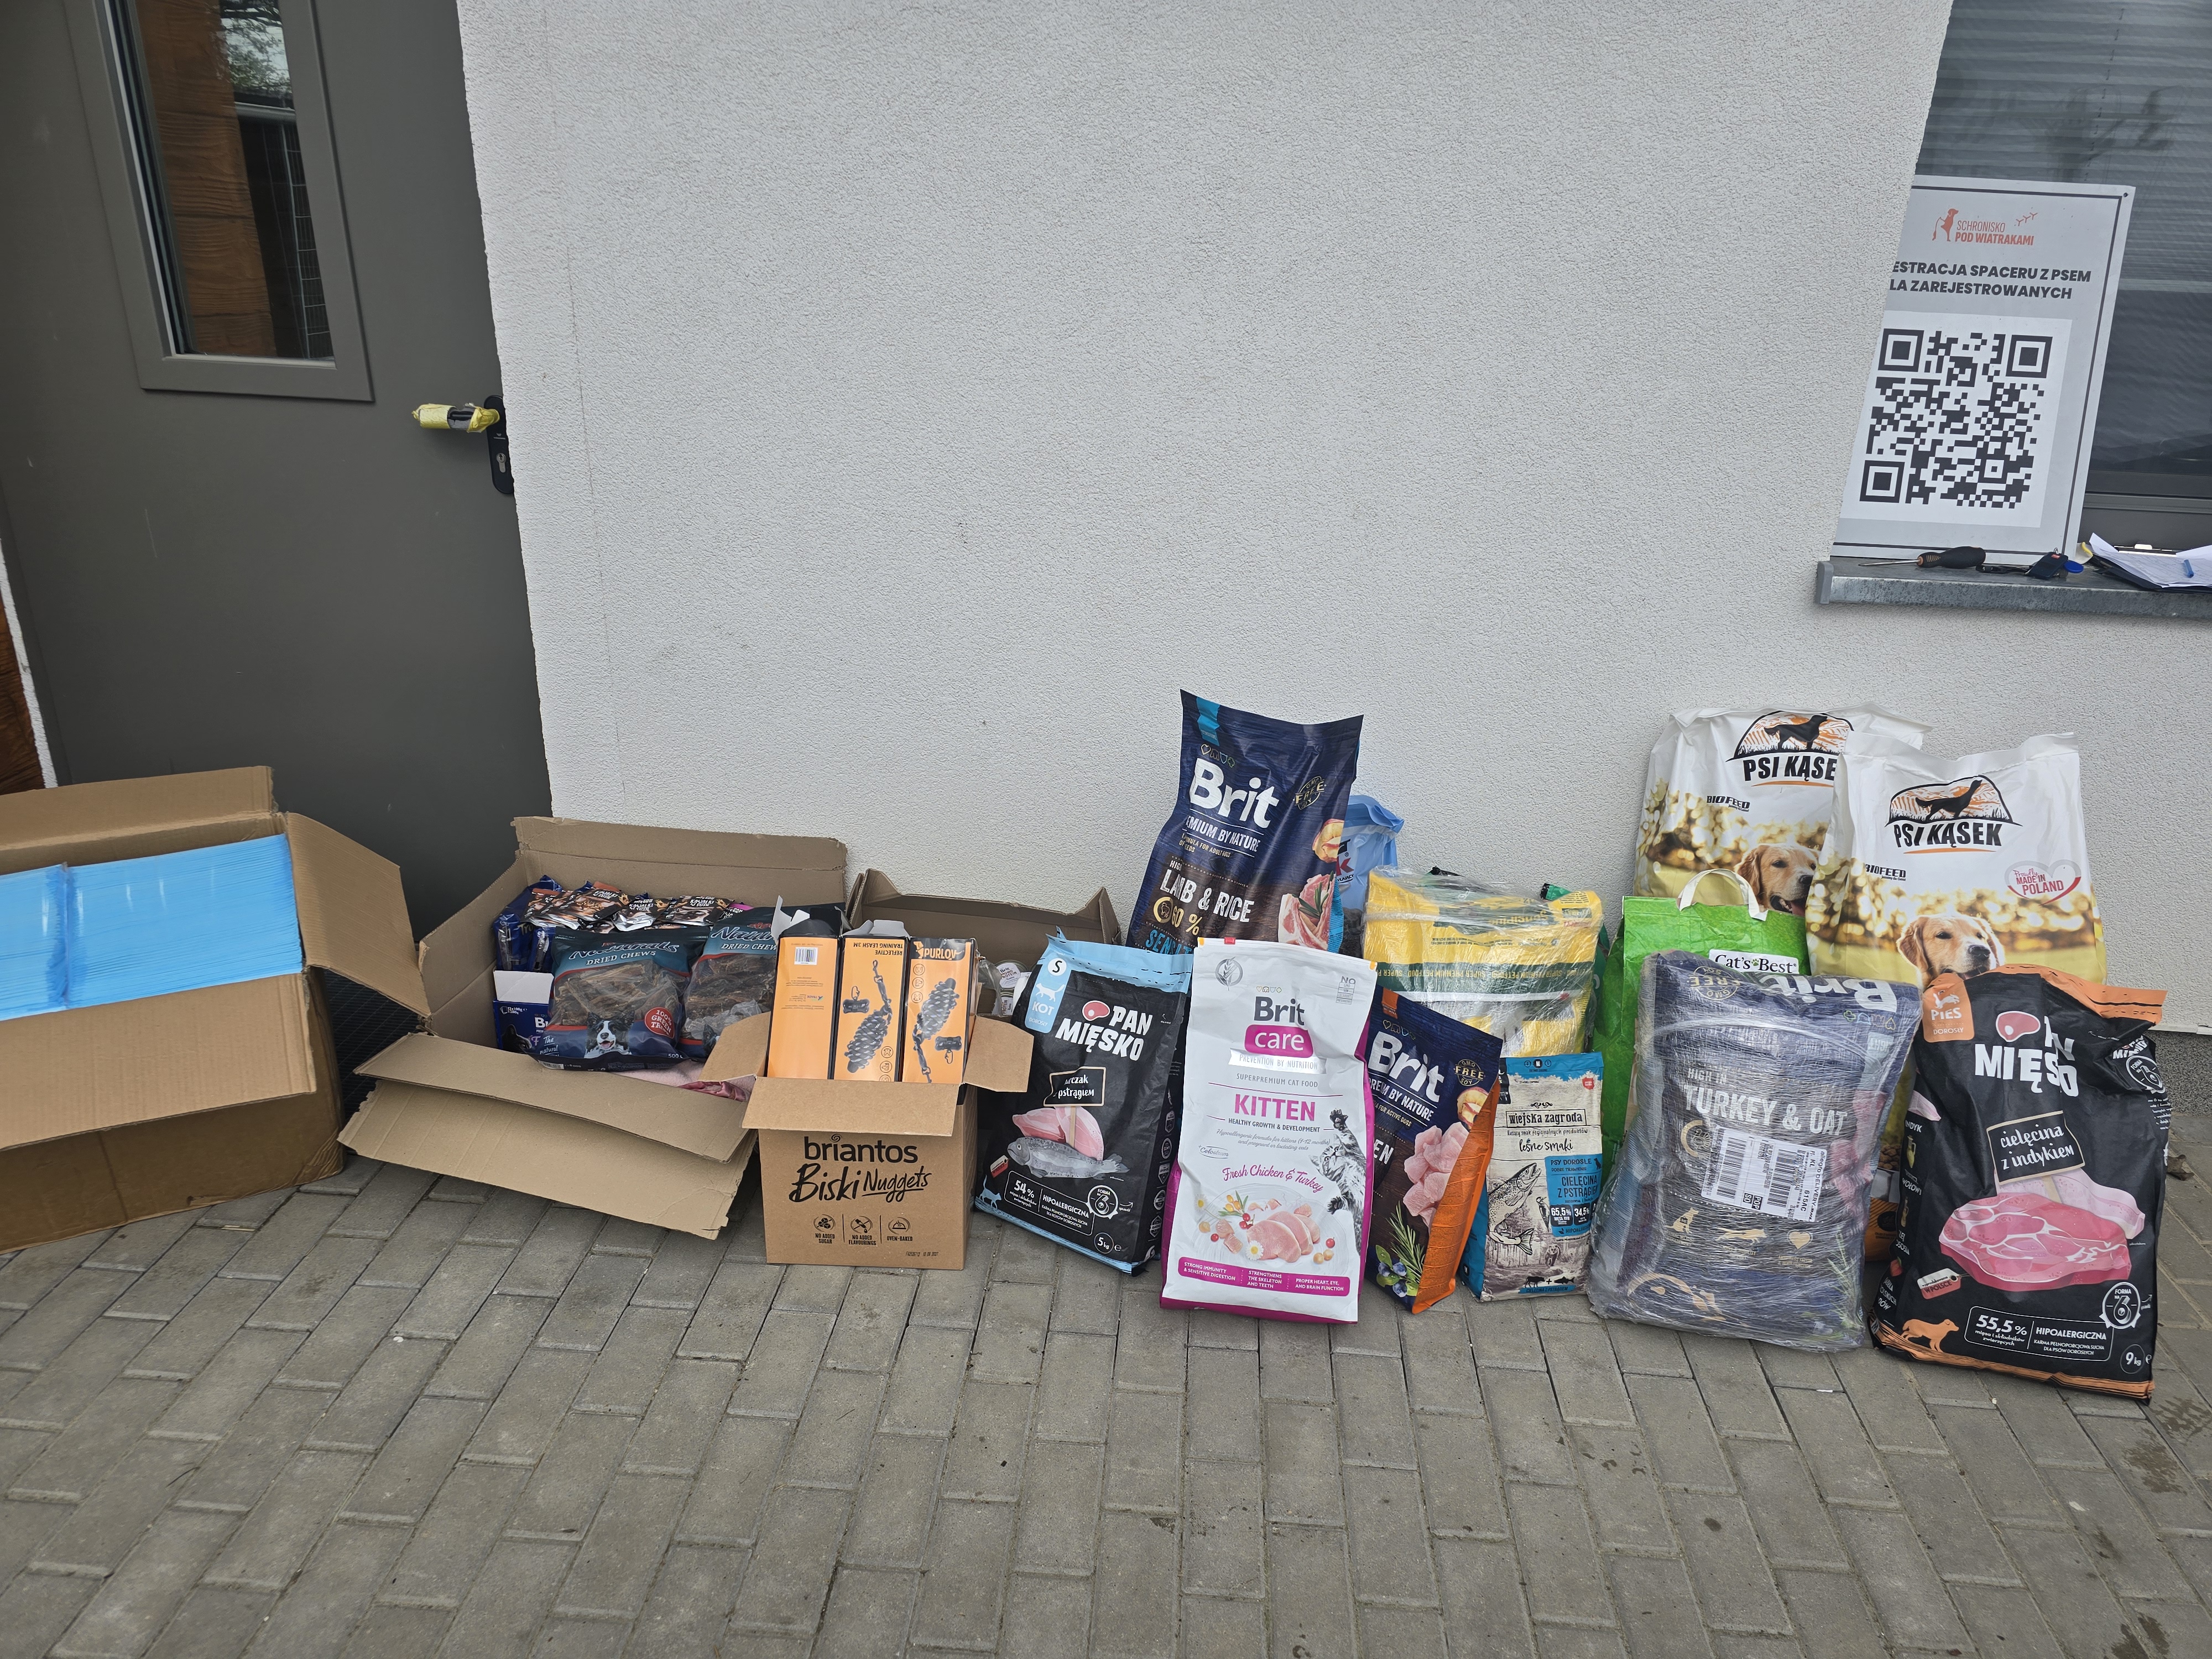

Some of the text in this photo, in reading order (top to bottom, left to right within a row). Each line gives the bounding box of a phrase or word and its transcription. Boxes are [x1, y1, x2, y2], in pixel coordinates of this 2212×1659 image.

[1957, 220, 2005, 232] SCHRONISKO
[1955, 232, 2034, 246] POD WIATRAKAMI
[1970, 265, 2038, 279] SPACERU
[2039, 268, 2049, 280] Z
[2051, 269, 2091, 282] PSEM
[1889, 279, 2073, 299] LA ZAREJESTROWANYCH
[1743, 756, 1780, 781] PSI
[1190, 758, 1280, 828] Brit
[1295, 781, 1325, 806] FREE
[1218, 829, 1232, 843] BY
[1229, 832, 1261, 852] NATURE
[1893, 821, 2002, 848] PSI KĄSEK
[1865, 864, 1906, 878] BIOFEED
[2012, 868, 2038, 878] Proudly
[2016, 874, 2046, 885] MADE IN
[2023, 880, 2064, 895] POLAND
[1198, 888, 1212, 911] &
[1213, 891, 1255, 922] RICE
[1185, 914, 1202, 936] %
[586, 951, 656, 966] DRIED CHEWS
[924, 948, 957, 960] PURLOV
[1052, 960, 1062, 973] S
[1715, 954, 1792, 973] Cat's Best
[1689, 975, 1741, 988] FREE
[1707, 988, 1731, 998] GMO
[1032, 1001, 1055, 1016] KOT
[1254, 996, 1305, 1026] Brit
[1931, 1008, 1962, 1021] PIES
[651, 1015, 671, 1033] GREEN
[1109, 1005, 1152, 1035] PAN
[543, 1035, 554, 1044] The
[1055, 1018, 1144, 1061] MIĘSKO
[1255, 1032, 1304, 1051] care
[540, 1045, 558, 1055] natural
[1239, 1055, 1274, 1066] PREVENTION
[1287, 1060, 1318, 1070] NUTRITION
[1368, 1031, 1444, 1103] Brit
[1236, 1073, 1286, 1085] SUPERPREMIUM
[1455, 1065, 1484, 1079] FREE
[1687, 1068, 1727, 1084] HIGH IN
[1058, 1087, 1094, 1100] pstrągiem
[1234, 1094, 1316, 1121] KITTEN
[1388, 1088, 1434, 1122] BY NATURE
[1683, 1084, 1848, 1136] TURKEY & OAT
[1386, 1109, 1401, 1121] ACTIVE
[1545, 1113, 1583, 1125] zagroda
[1228, 1118, 1251, 1126] HEALTHY
[1252, 1121, 1275, 1129] GROWTH
[1282, 1124, 1321, 1133] DEVELOPMENT
[1217, 1129, 1253, 1141] Hypoallergenic
[1253, 1133, 1272, 1142] formula
[1311, 1138, 1331, 1146] months)
[2000, 1124, 2064, 1148] cielęcina
[804, 1134, 918, 1164] briantos
[1199, 1146, 1229, 1157] Colostrum
[1248, 1141, 1270, 1149] pregnant
[1276, 1143, 1297, 1151] lactating
[1545, 1138, 1573, 1151] smaki
[1817, 1151, 1827, 1173] allegro
[2001, 1143, 2074, 1170] z indykiem
[789, 1163, 932, 1203] Biski Nuggets
[1222, 1164, 1324, 1193] Fresh Chicken & Turkey
[1562, 1175, 1597, 1187] CIELĘCINA
[1014, 1180, 1035, 1198] 54 %
[1557, 1188, 1563, 1198] Z
[1812, 1173, 1821, 1207] DELIVERY
[1042, 1194, 1089, 1218] HIPOALERGICZNA
[1184, 1261, 1203, 1270] STRONG
[1187, 1268, 1235, 1281] SENSITIVE DIGESTION
[1249, 1270, 1282, 1279] STRENGTHENS
[1930, 1280, 1952, 1292] POLSCE
[1976, 1314, 2027, 1335] 55,5 %
[1995, 1333, 2025, 1342] składników
[2035, 1327, 2106, 1340] HIPOALERGICZNA
[1983, 1337, 2015, 1346] zwierzęcych
